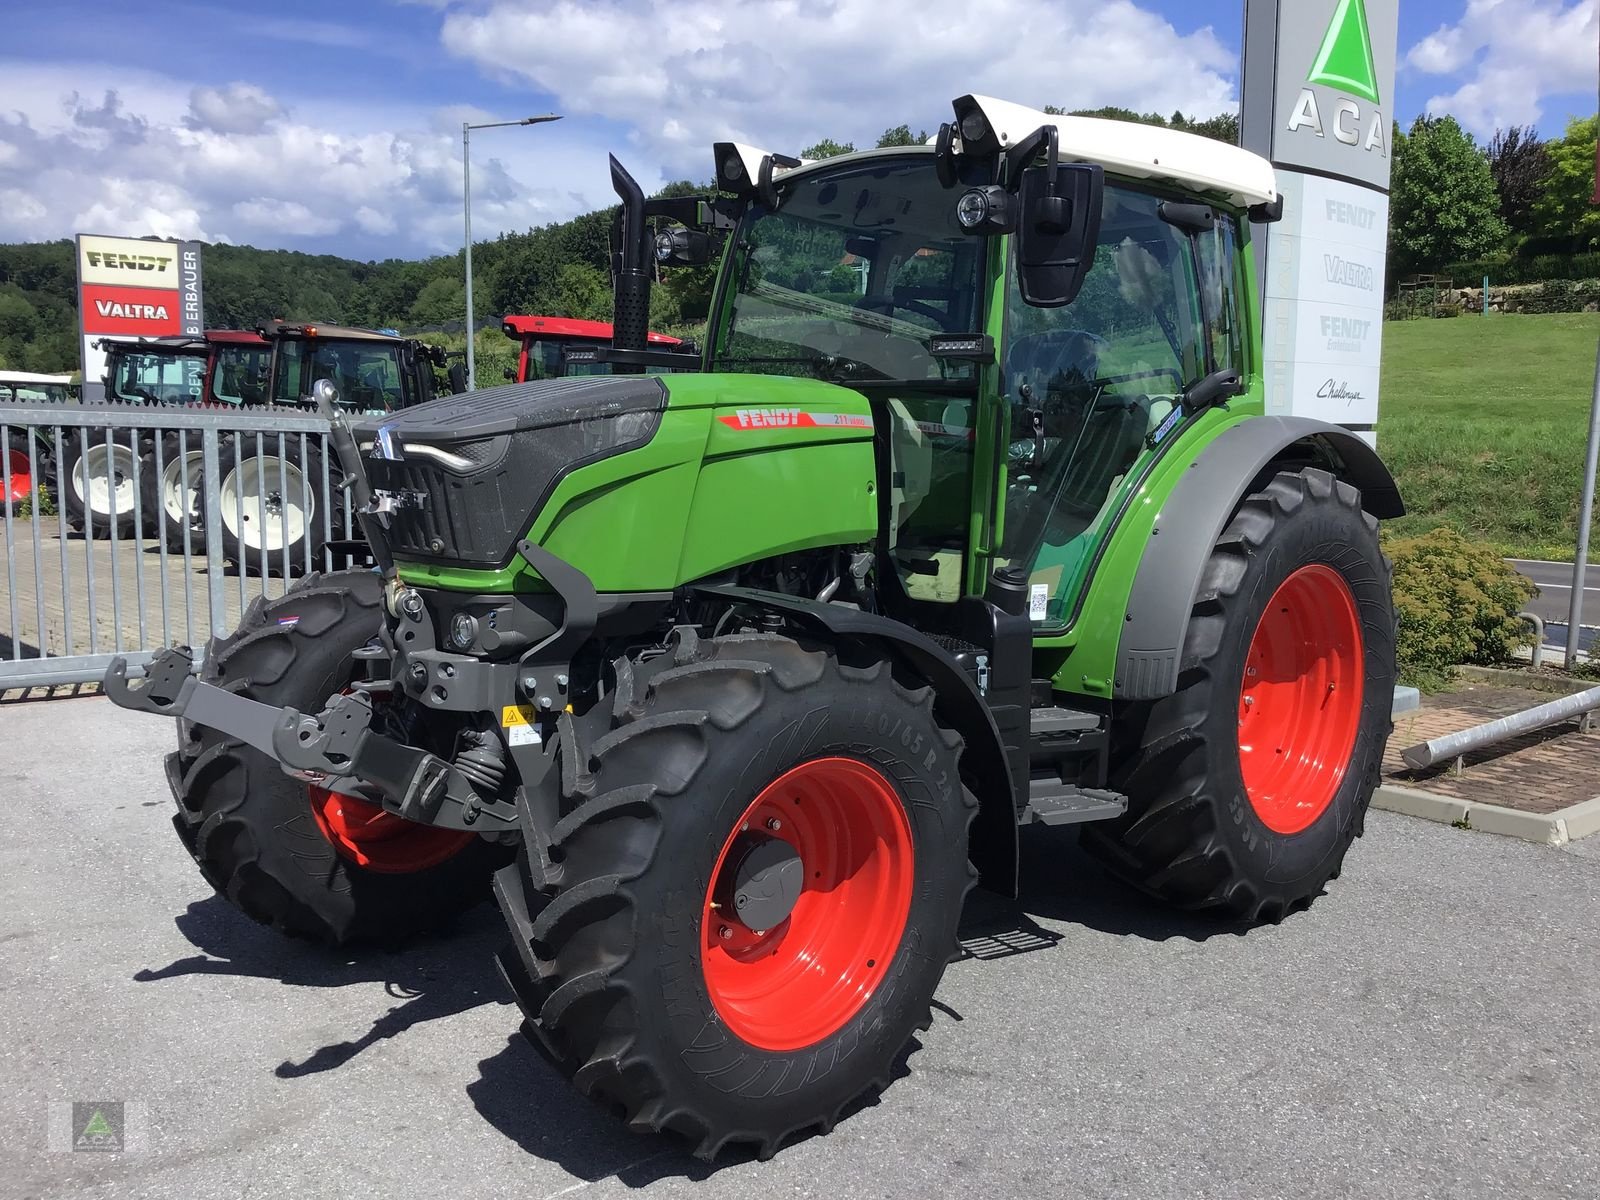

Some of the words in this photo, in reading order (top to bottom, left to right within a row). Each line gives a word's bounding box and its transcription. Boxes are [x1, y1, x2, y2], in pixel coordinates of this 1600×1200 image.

[1287, 88, 1386, 158] ACA
[1325, 199, 1376, 230] FENDT
[86, 251, 172, 272] FENDT
[1324, 254, 1373, 291] VALTRA
[94, 299, 169, 320] VALTRA
[1320, 316, 1371, 340] FENDT
[1316, 378, 1366, 407] Challenger
[736, 408, 800, 427] FENDT
[834, 414, 848, 424] 211
